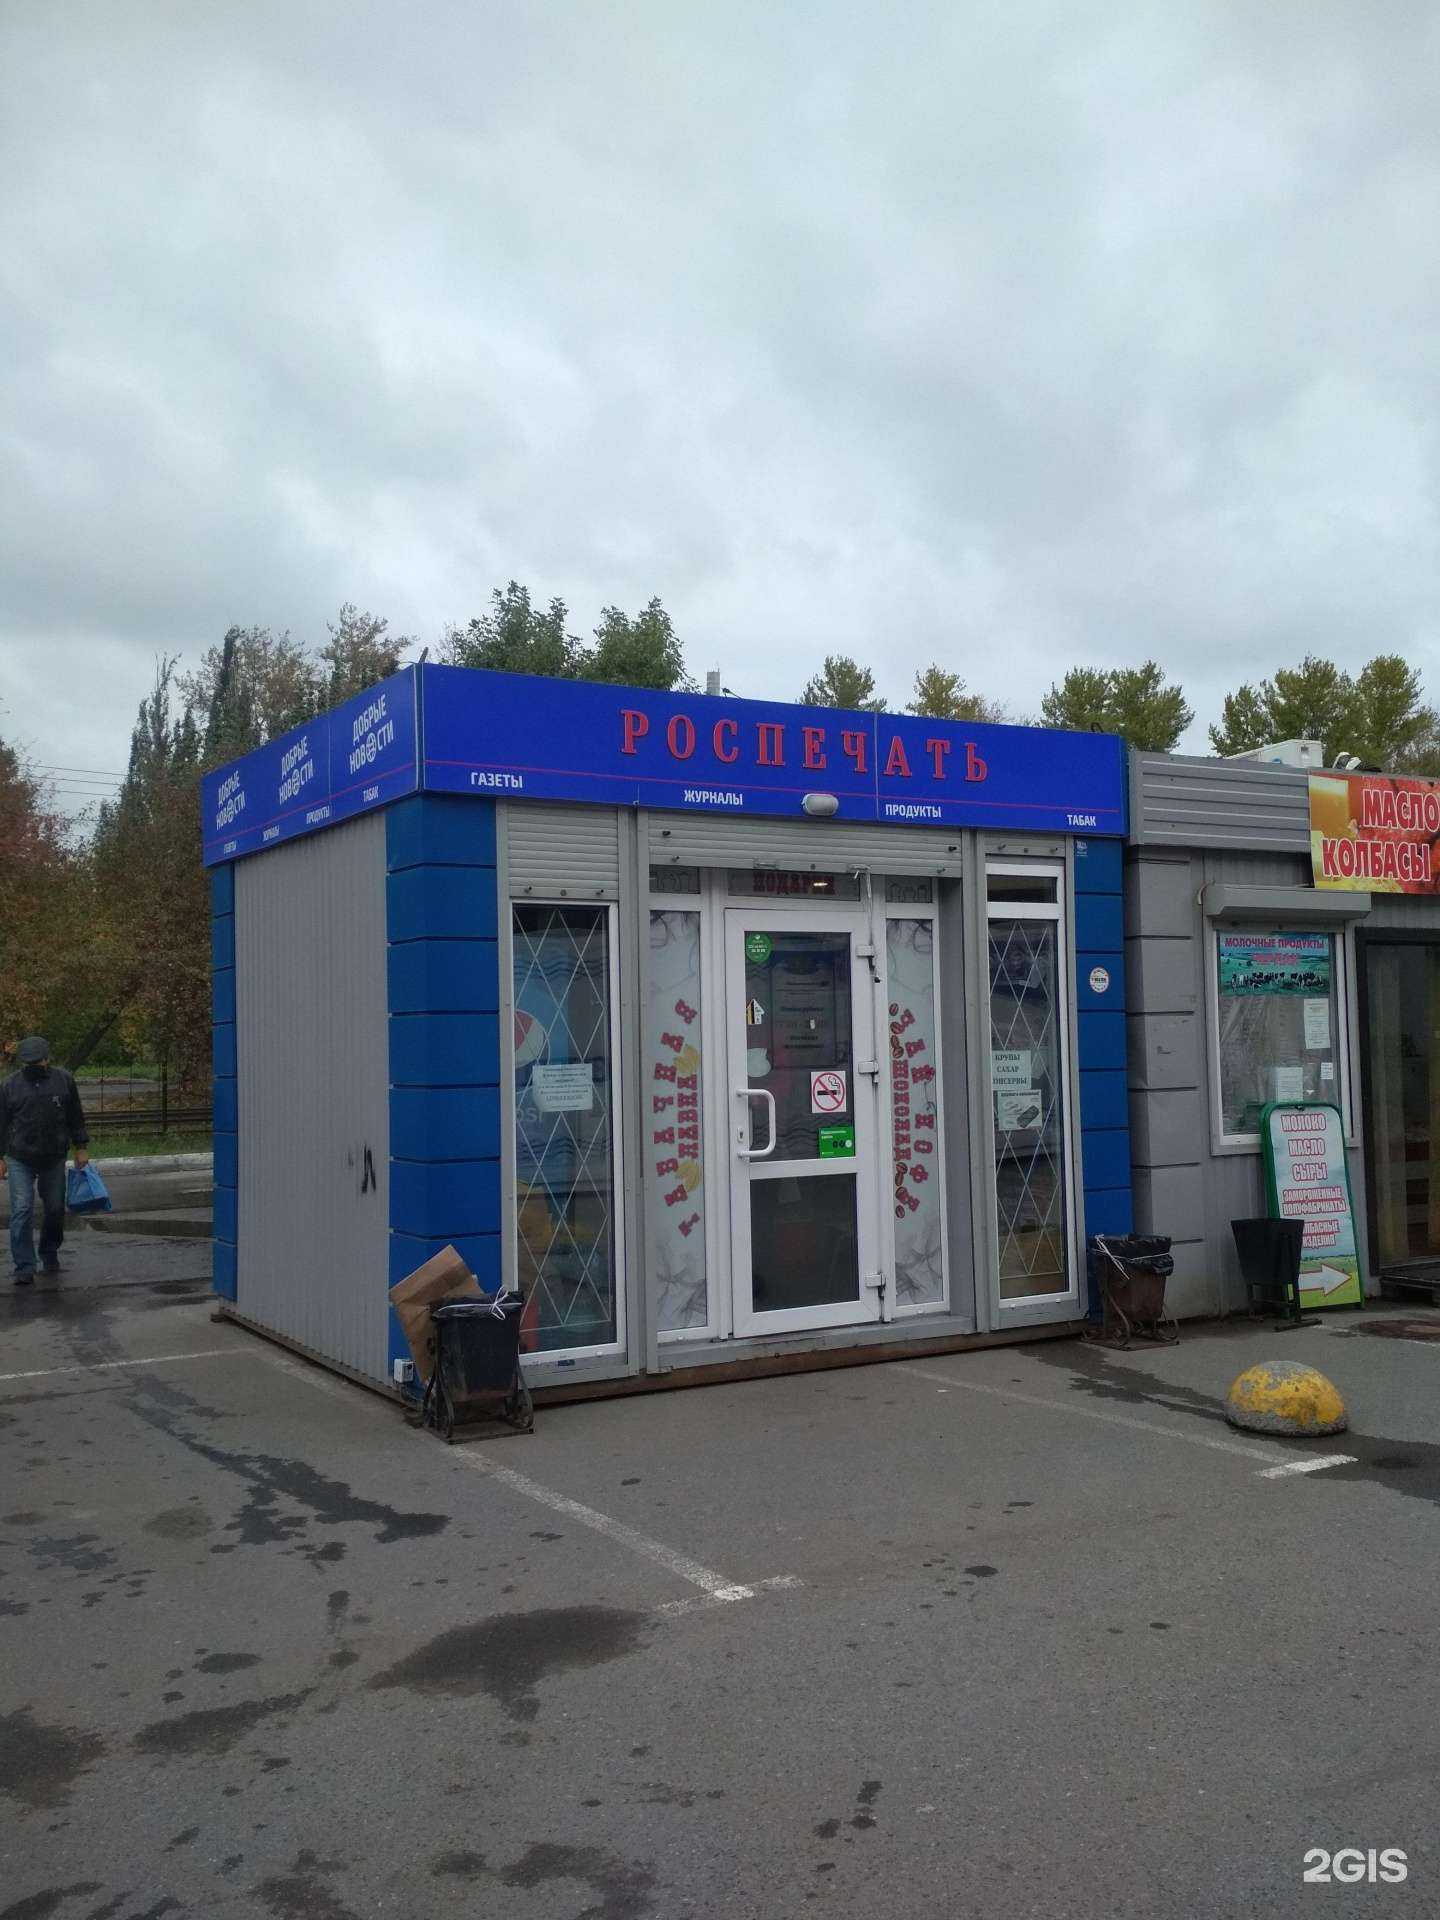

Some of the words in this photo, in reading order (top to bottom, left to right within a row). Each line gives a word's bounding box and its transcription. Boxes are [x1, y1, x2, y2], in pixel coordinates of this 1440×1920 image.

[352, 694, 387, 746] ДОБРЫЕ
[620, 709, 988, 782] РОСПЕЧАТЬ
[281, 735, 309, 780] ДОБРЫЕ
[218, 770, 240, 808] ДОБРЫЕ
[470, 772, 523, 789] ГАЗЕТЫ
[683, 789, 743, 806] ЖУРНАЛЫ
[885, 803, 942, 818] ПРОДУКТЫ
[1362, 789, 1440, 832] МАСЛО
[1066, 814, 1097, 827] ТАБАК
[1321, 838, 1432, 882] КОЛБАСЫ
[1224, 937, 1276, 949] МОЛОЧНЫЕ
[1278, 938, 1325, 950] ПРОДУКТЫ
[995, 1053, 1020, 1061] КРУПЫ
[992, 1077, 1028, 1085] ОНСЕРВЫ
[1280, 1113, 1327, 1132] МОЛОКО
[1288, 1138, 1325, 1157] МАСЛО
[1292, 1162, 1328, 1182] СЫРЫ
